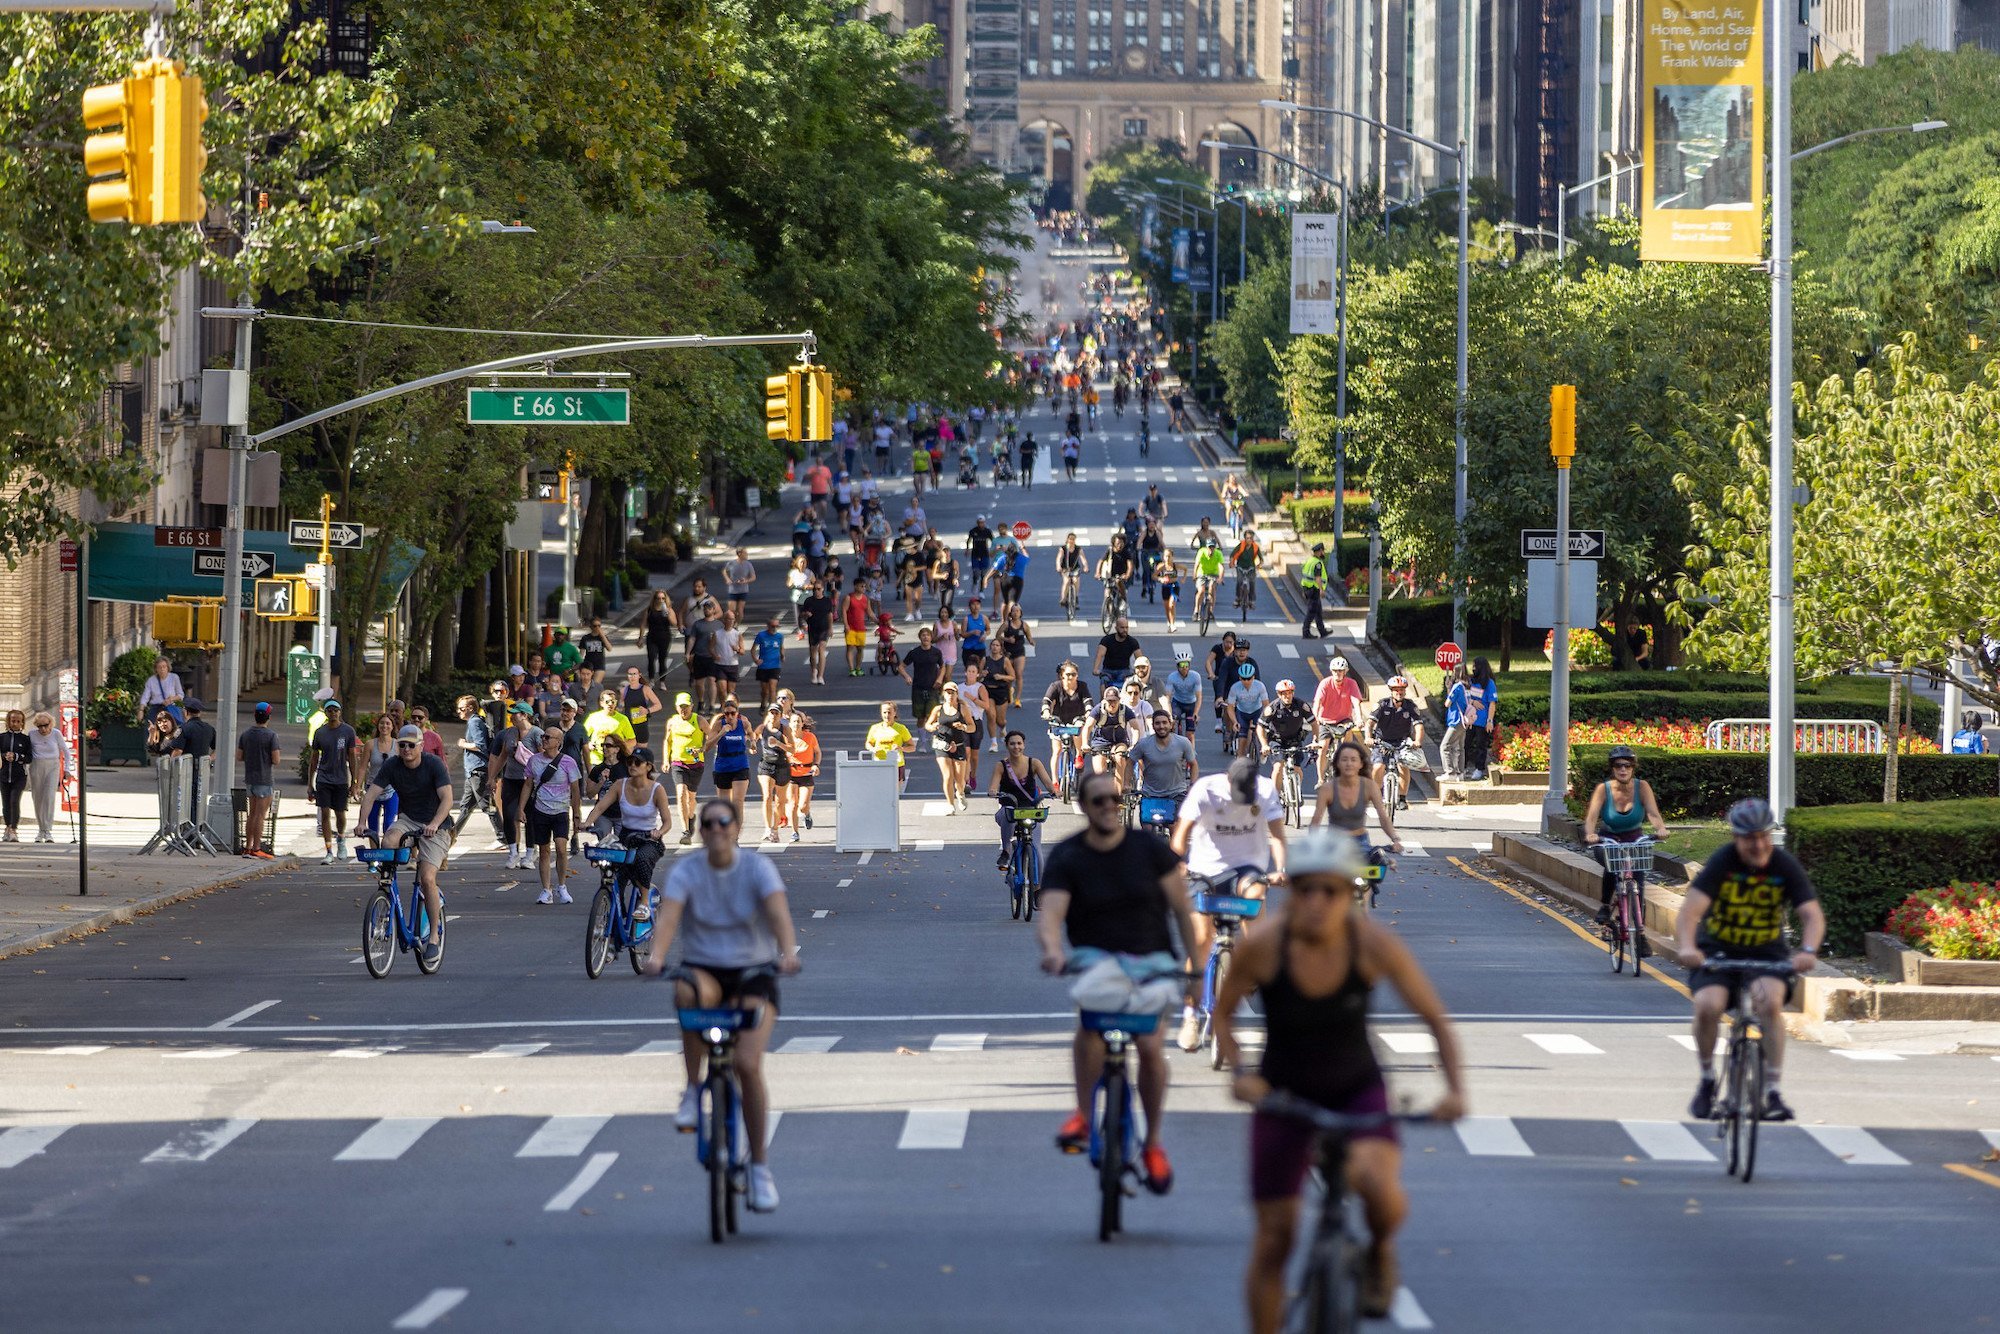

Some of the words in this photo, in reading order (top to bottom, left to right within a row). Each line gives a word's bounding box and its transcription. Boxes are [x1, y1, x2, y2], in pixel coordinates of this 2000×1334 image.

[1661, 6, 1679, 22] By
[1683, 7, 1719, 20] Land,
[1723, 7, 1745, 21] Air,
[1651, 23, 1695, 36] Home,
[1699, 23, 1724, 35] and
[1728, 23, 1757, 35] Sea:
[1659, 39, 1685, 51] The
[1689, 39, 1730, 51] World
[1734, 39, 1749, 51] of
[1661, 55, 1699, 67] Frank
[1702, 55, 1745, 67] Walter
[514, 396, 524, 416] E
[532, 396, 555, 416] 66
[563, 396, 583, 416] St
[300, 528, 321, 539] ONE
[330, 530, 352, 540] WAY
[1013, 527, 1031, 536] STOP
[168, 531, 175, 545] E
[179, 531, 194, 545] 66
[198, 531, 210, 546] St
[1534, 538, 1557, 549] ONE
[1568, 539, 1592, 550] WAY
[205, 557, 226, 569] ONE
[1437, 650, 1461, 663] STOP
